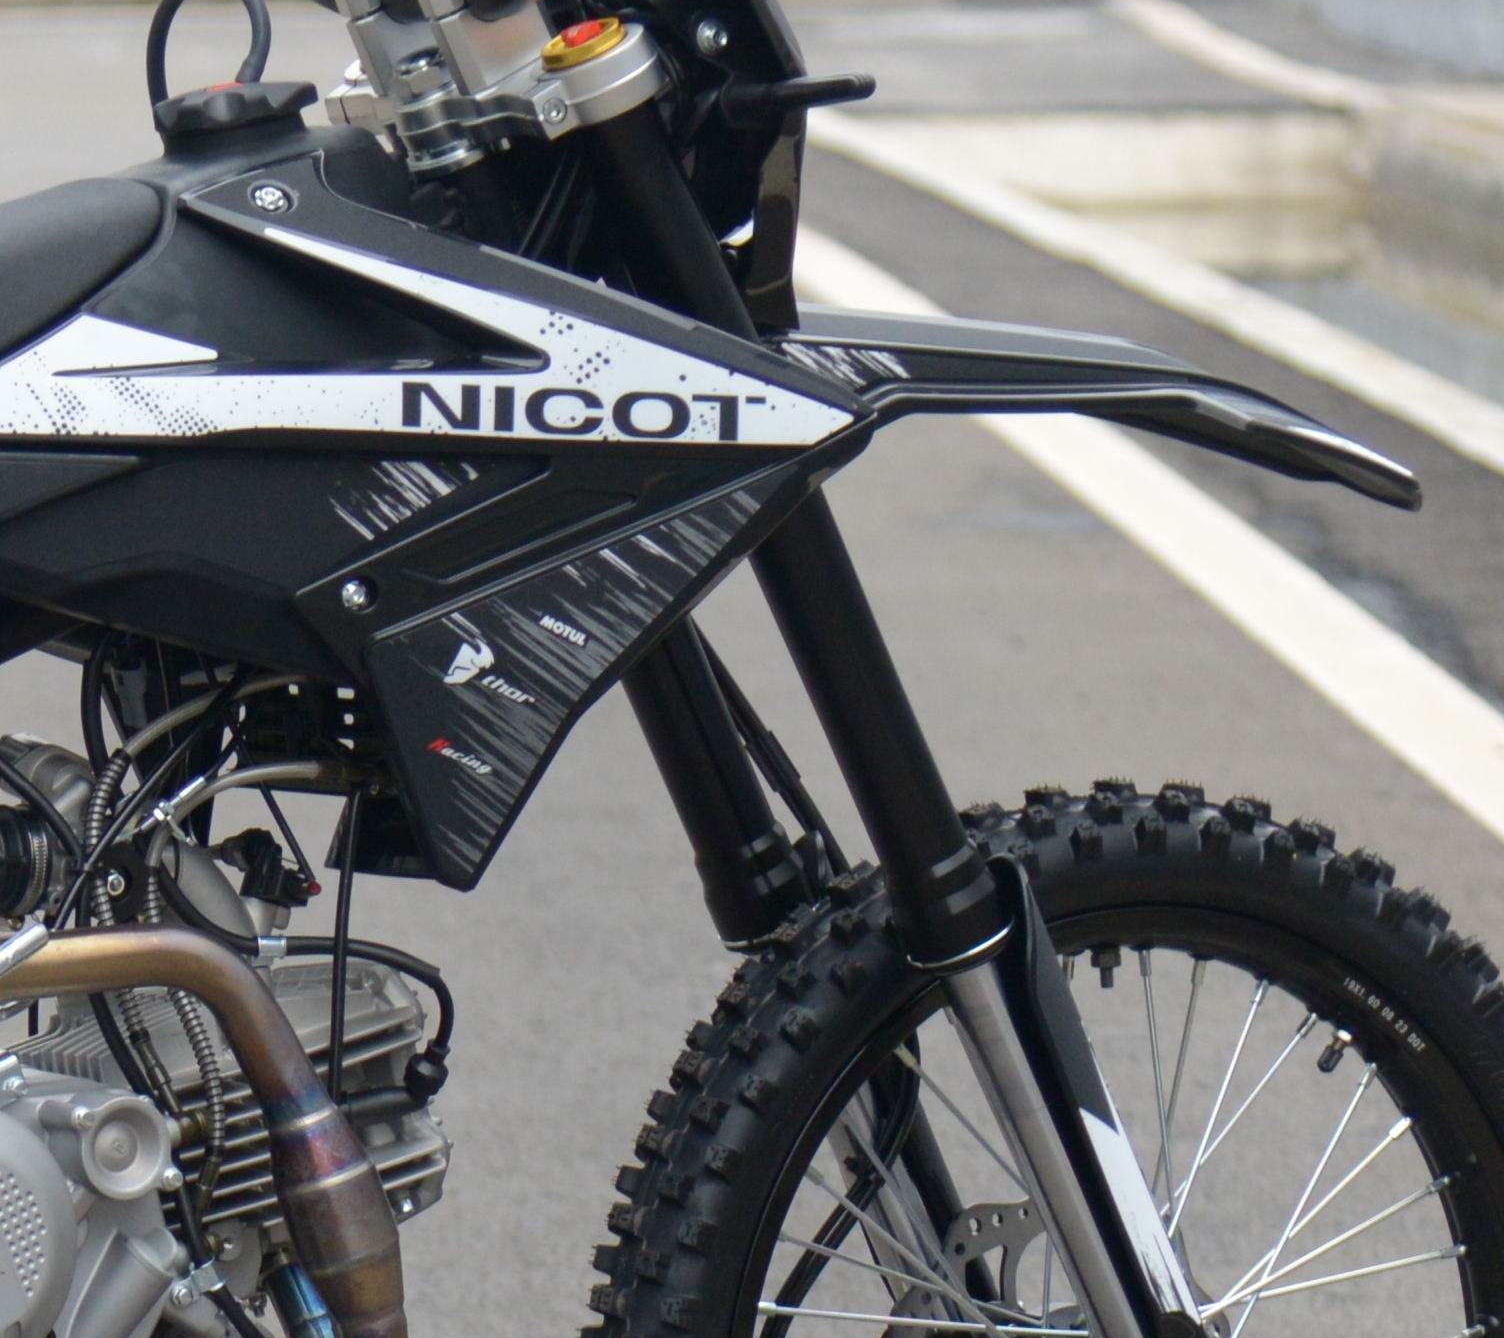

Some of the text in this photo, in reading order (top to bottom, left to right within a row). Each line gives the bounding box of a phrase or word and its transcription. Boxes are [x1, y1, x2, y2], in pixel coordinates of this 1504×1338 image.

[402, 381, 766, 442] NICOT
[539, 615, 587, 646] MOTUL
[481, 675, 535, 703] thor
[427, 737, 492, 774] Racing
